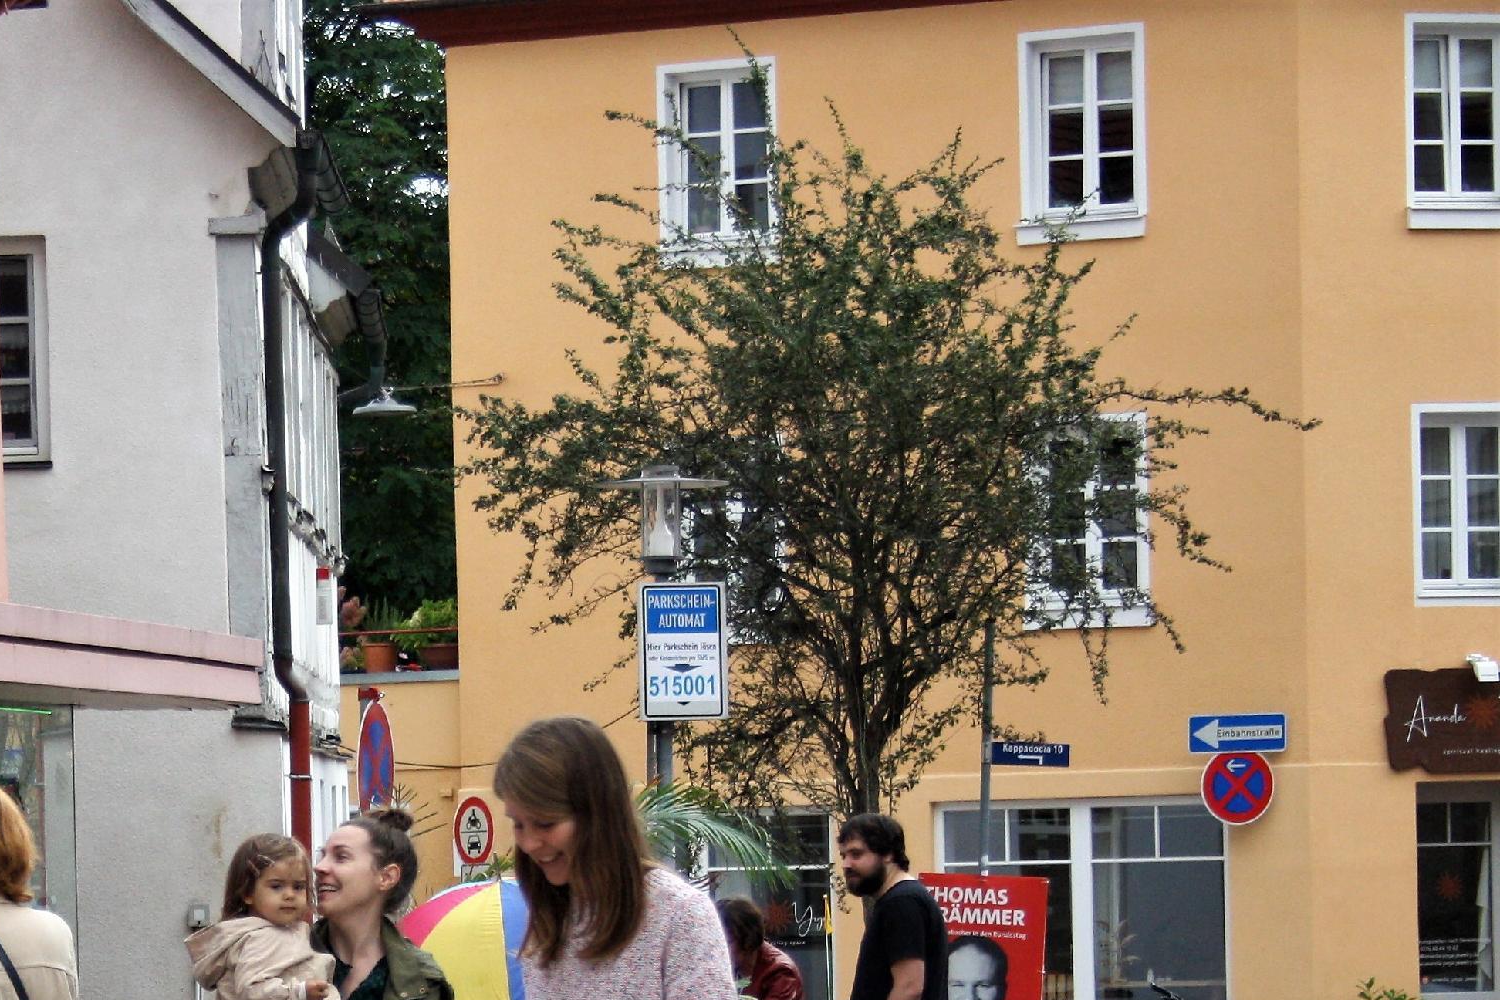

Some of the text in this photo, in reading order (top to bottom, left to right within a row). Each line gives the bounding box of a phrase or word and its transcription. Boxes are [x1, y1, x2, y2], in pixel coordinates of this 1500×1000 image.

[648, 594, 715, 609] PARKSCHEIN-
[658, 613, 706, 628] AUTOMAT
[647, 641, 717, 651] Hier Parkschein lösen
[649, 675, 715, 697] 515001
[1217, 727, 1280, 738] Einbahnstraße
[1053, 745, 1063, 754] 10
[791, 901, 826, 938] Yog
[940, 904, 1025, 927] RÄMMER
[993, 931, 1027, 941] Bundestag
